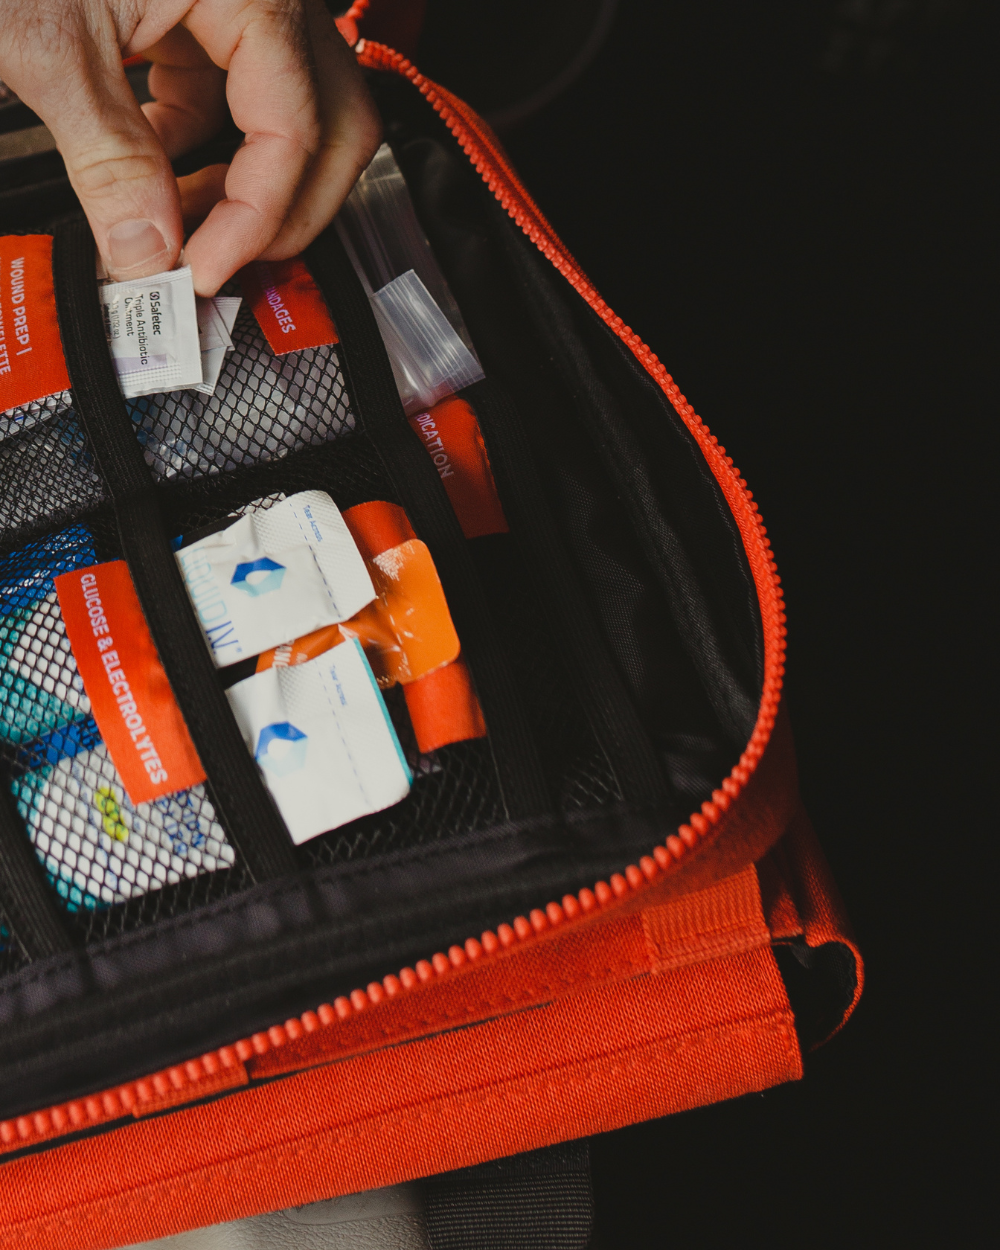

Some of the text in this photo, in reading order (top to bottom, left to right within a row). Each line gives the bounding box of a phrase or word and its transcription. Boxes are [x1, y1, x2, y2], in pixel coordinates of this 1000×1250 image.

[10, 257, 25, 304] WOUND
[13, 306, 29, 345] PREP
[133, 293, 150, 366] Triple Antibiotic
[150, 301, 162, 336] Safetec
[80, 573, 110, 638] GLUCOSE
[181, 546, 228, 624] LIQUID
[97, 636, 113, 652] &
[101, 650, 168, 785] ELECTROLYTES
